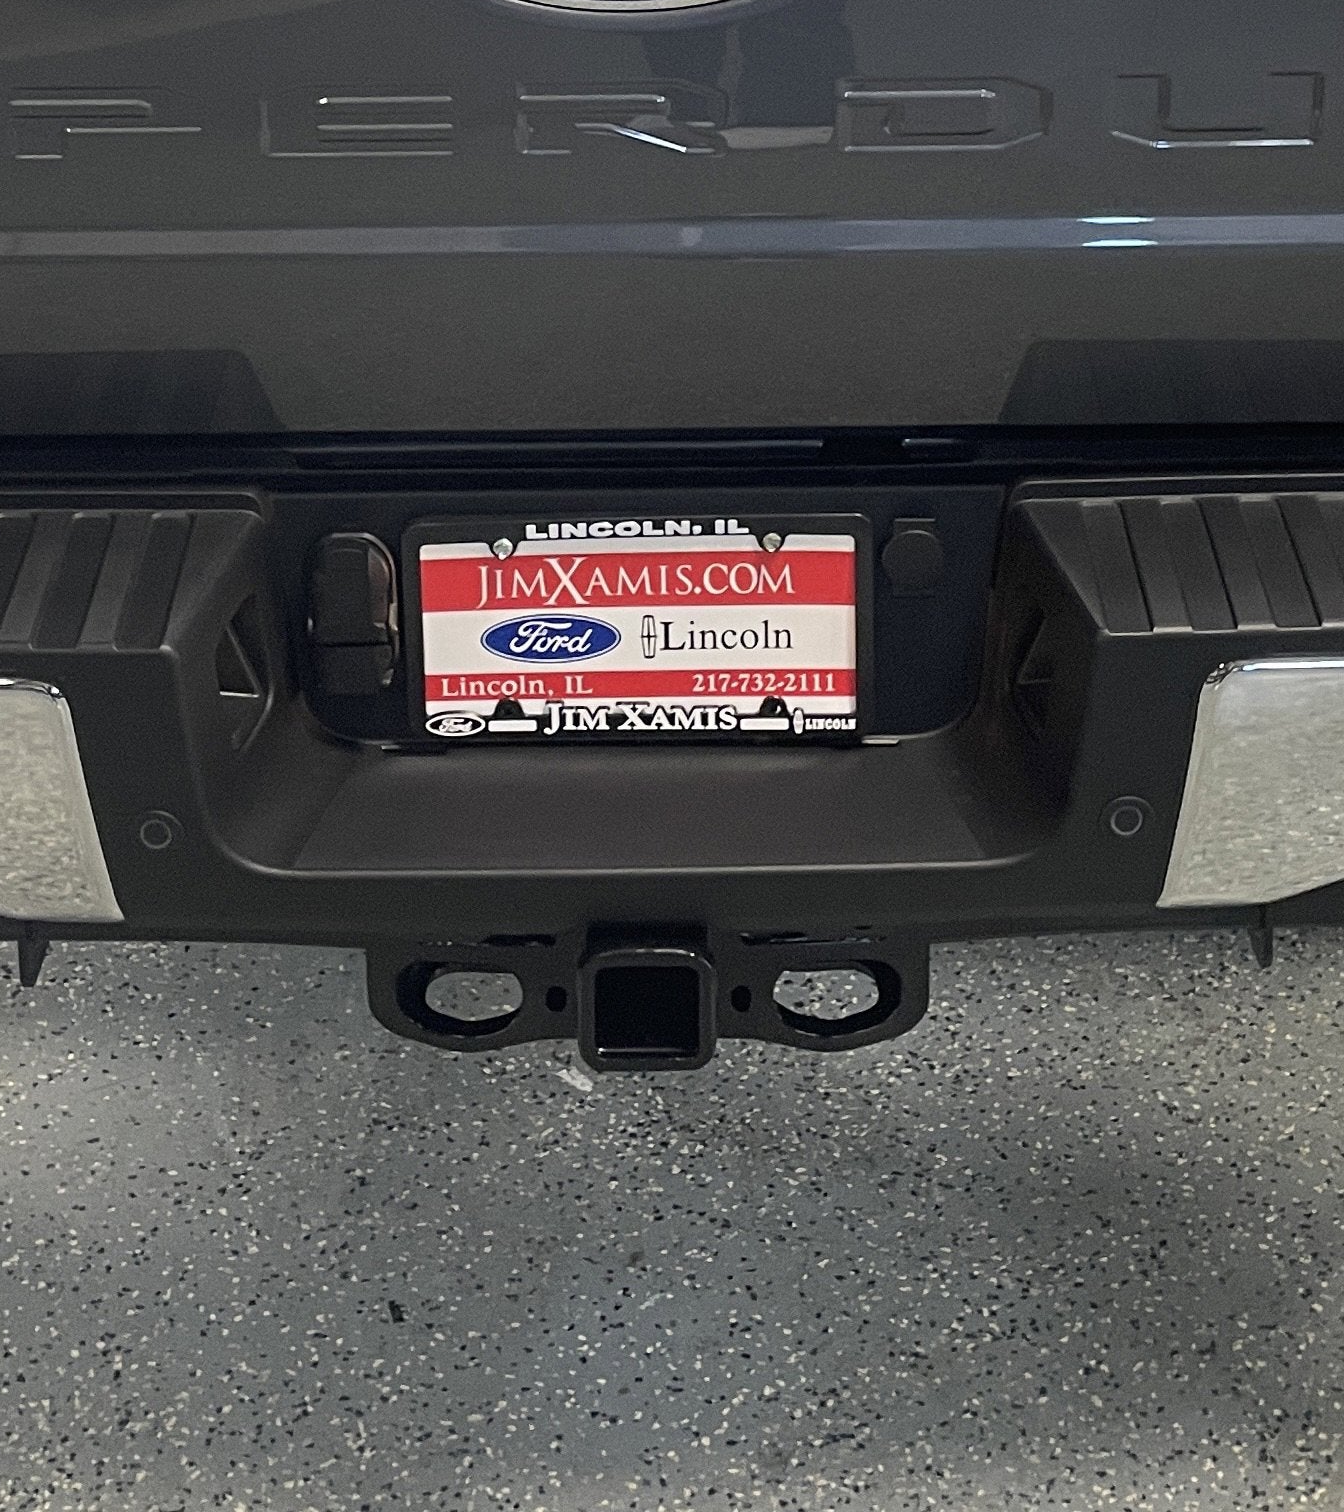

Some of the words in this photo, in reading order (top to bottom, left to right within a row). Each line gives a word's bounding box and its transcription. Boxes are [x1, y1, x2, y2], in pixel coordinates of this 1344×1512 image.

[524, 519, 703, 541] LINCOLN,
[714, 518, 751, 536] IL
[508, 619, 593, 655] Ford
[660, 618, 794, 652] Lincoln
[440, 674, 555, 699] Lincoln,
[564, 675, 594, 696] IL
[692, 672, 837, 694] 217-732-2111
[543, 702, 611, 736] JIM
[615, 701, 738, 731] XAMIS
[805, 717, 857, 730] LINCOLN
